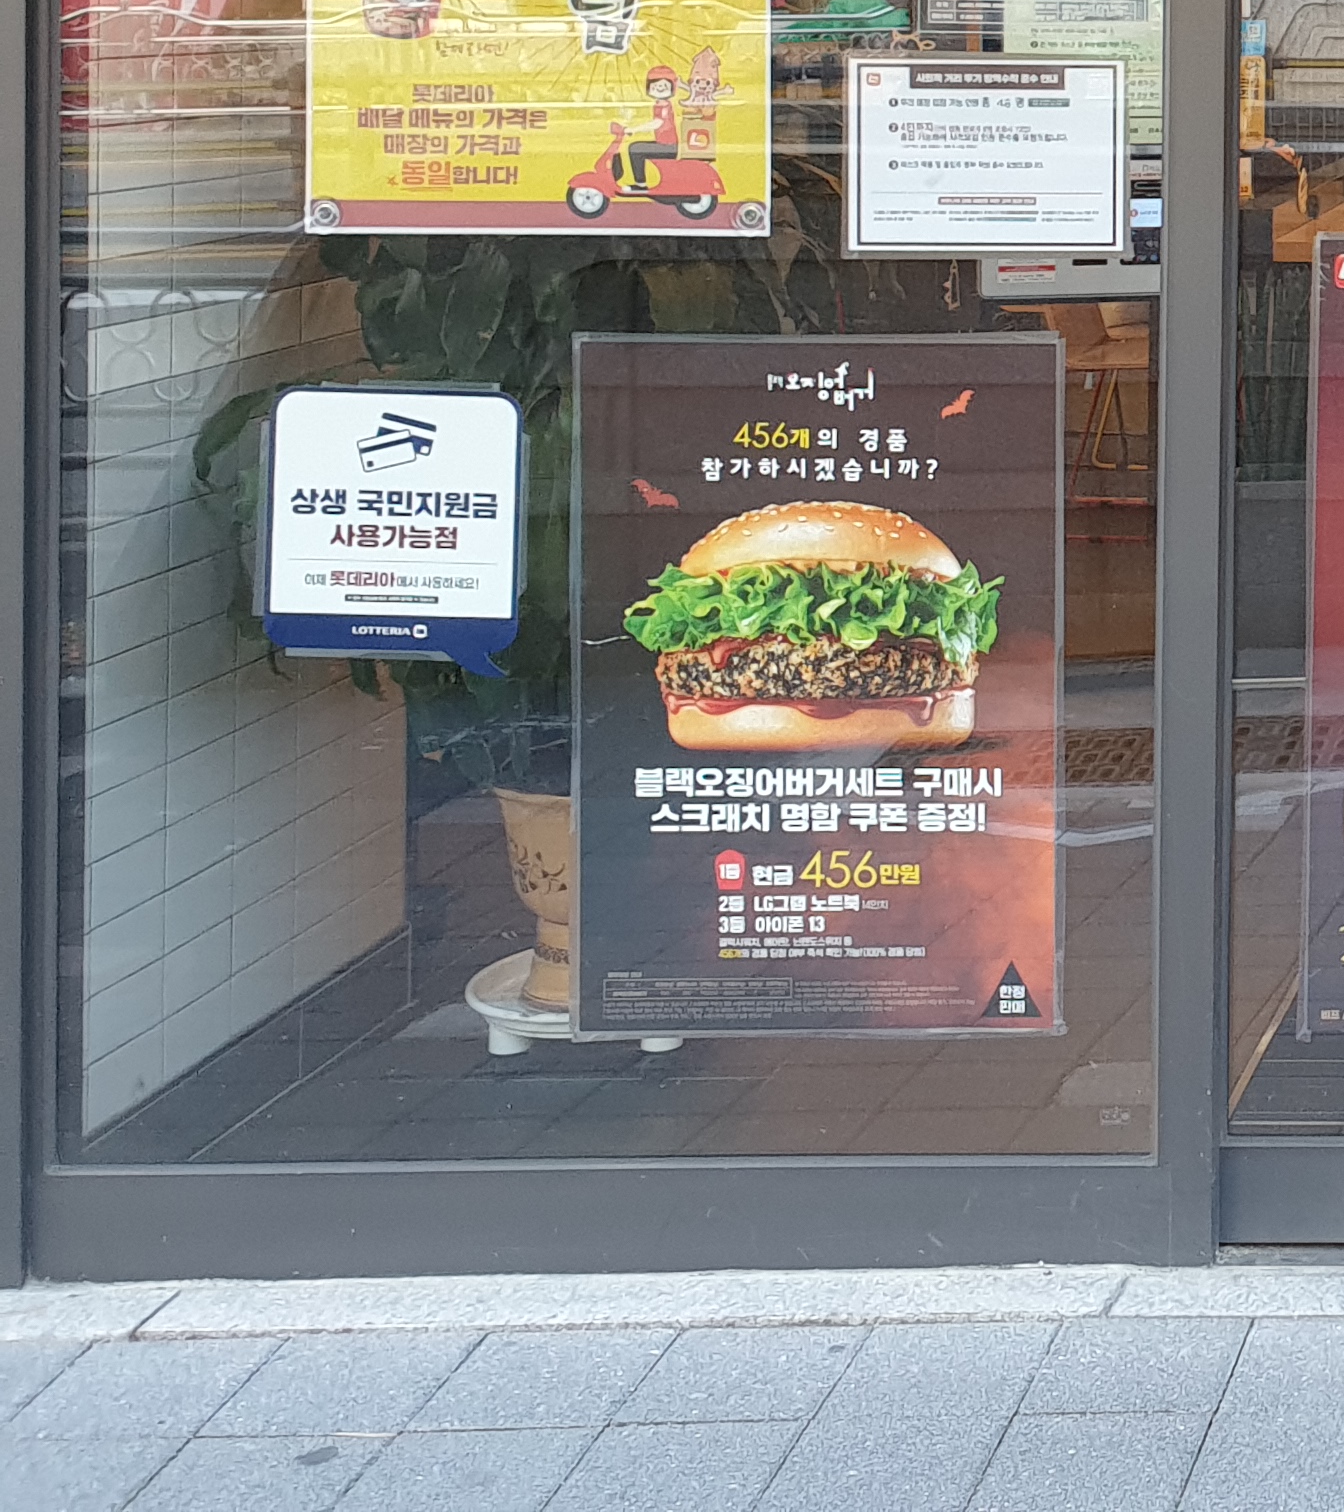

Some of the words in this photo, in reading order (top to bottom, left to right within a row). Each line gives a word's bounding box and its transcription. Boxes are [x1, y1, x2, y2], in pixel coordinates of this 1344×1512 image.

[357, 108, 404, 129] 배달
[408, 109, 474, 129] 메뉴의
[481, 108, 548, 130] 가격은
[384, 134, 449, 156] 매장의
[456, 134, 522, 156] 가격과
[401, 161, 519, 186] 동일합니다!
[859, 428, 908, 452] 경품
[701, 457, 939, 483] 참가하시겠습니까?
[290, 488, 347, 515] 상생
[357, 489, 498, 520] 국민지원금
[330, 524, 458, 550] 사용가능점
[351, 626, 411, 637] LOTTERIA
[634, 768, 904, 798] 블랙오징어버거세트
[912, 768, 1002, 797] 구매시
[650, 804, 769, 833] 스크래치
[780, 803, 841, 832] 명함
[849, 804, 908, 832] 쿠폰
[917, 804, 986, 833] 증정!
[752, 865, 793, 886] 현금
[799, 849, 920, 888] 456만원
[753, 895, 807, 911] LG그램
[810, 894, 860, 911] 노트북
[755, 916, 804, 933] 아이폰
[808, 916, 825, 933] 13
